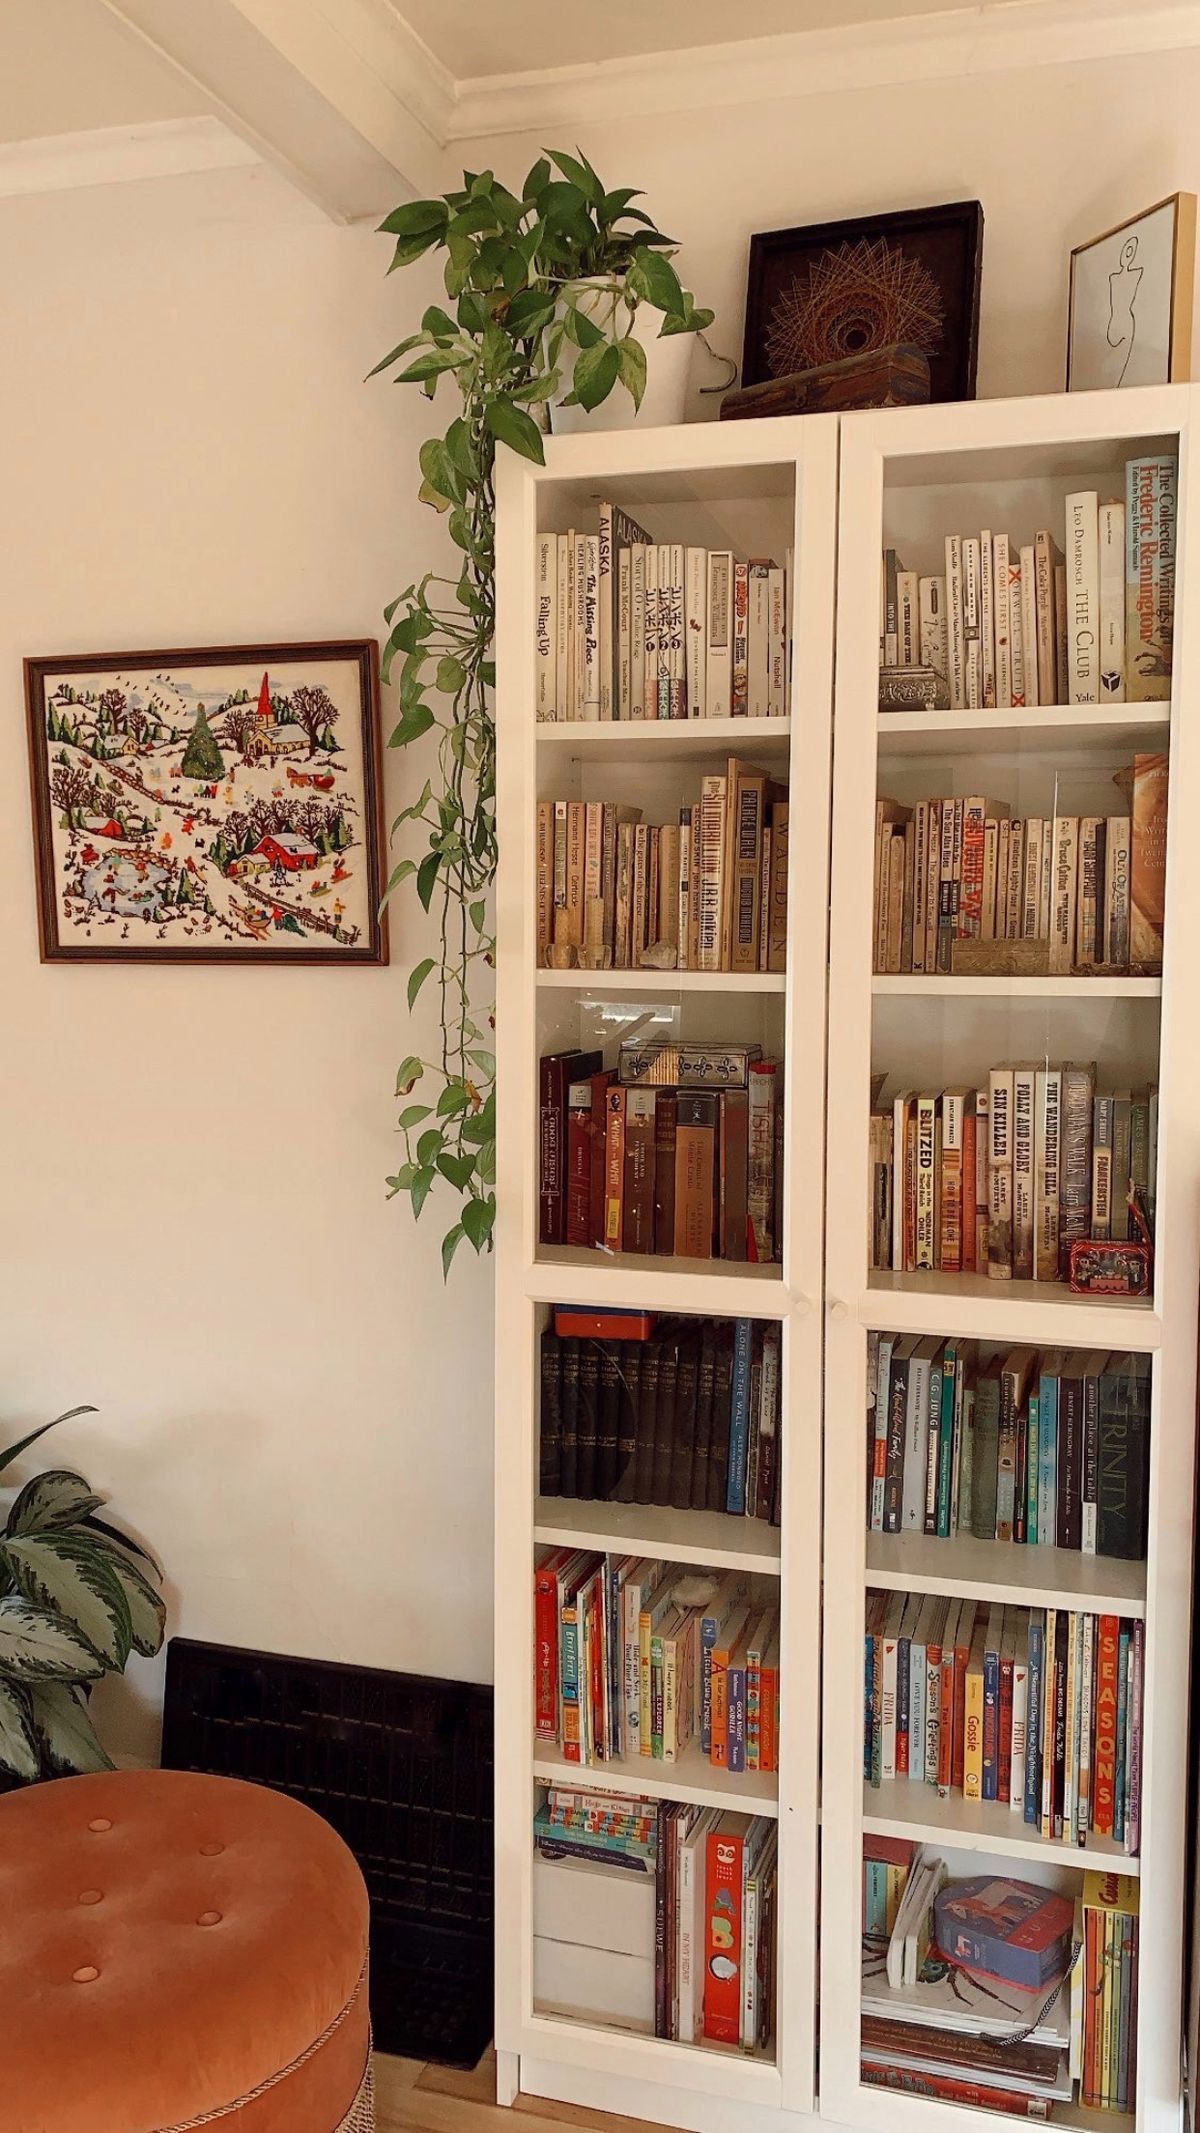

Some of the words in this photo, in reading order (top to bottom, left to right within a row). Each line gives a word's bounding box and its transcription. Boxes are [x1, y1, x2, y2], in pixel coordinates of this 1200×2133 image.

[1159, 463, 1174, 491] The
[1140, 464, 1158, 536] Frederic
[1159, 493, 1174, 560] Collected
[577, 543, 585, 576] HEALING
[599, 517, 610, 577] ALASKA
[586, 576, 597, 593] The
[773, 587, 781, 599] Ian
[1137, 540, 1157, 641] Remington
[1157, 561, 1175, 623] Writings
[577, 578, 585, 626] MUSHROOMS
[1075, 588, 1089, 624] THE
[537, 596, 551, 637] Falling
[585, 596, 597, 635] Missing
[711, 603, 722, 638] Williams
[773, 600, 781, 636] McEwan
[538, 638, 551, 656] Up
[586, 637, 599, 665] Piece
[904, 637, 911, 646] OF
[773, 656, 781, 689] Nutshell
[1076, 693, 1096, 702] Yale
[740, 791, 757, 828] PALACE
[943, 808, 953, 820] The
[571, 806, 579, 841] Hermann
[943, 821, 952, 834] Sun
[571, 843, 579, 866] Hesse
[638, 836, 646, 849] the
[739, 830, 756, 858] WALK
[943, 835, 952, 849] Also
[1058, 839, 1071, 864] Bruce
[636, 850, 646, 870] gates
[942, 850, 952, 868] Rises
[637, 871, 645, 880] of
[637, 881, 645, 894] the
[773, 821, 788, 953] WALDEN
[1057, 864, 1071, 891] Catton
[571, 874, 579, 907] Gertrude
[699, 879, 718, 910] J.R.R.
[739, 879, 753, 906] NAGUIB
[699, 910, 718, 949] Tolkien
[739, 907, 753, 943] MAHFOUZ
[993, 1089, 1007, 1109] SIN
[1016, 1083, 1030, 1115] FOLLY
[1045, 1081, 1057, 1103] THE
[1067, 1080, 1087, 1109] DEAD
[1099, 1100, 1108, 1118] MARY
[610, 1121, 621, 1147] WHAT
[920, 1108, 932, 1169] BLITZED
[993, 1111, 1007, 1156] KILLER
[1016, 1117, 1030, 1138] AND
[1045, 1105, 1057, 1169] WANDERING
[1067, 1111, 1087, 1143] MAN'S
[1099, 1117, 1108, 1143] SHELLEY
[1016, 1140, 1030, 1174] GLORY
[1067, 1146, 1086, 1175] WALK
[610, 1159, 621, 1185] WHAT
[1045, 1171, 1056, 1196] HILL
[946, 1180, 956, 1196] HOW
[1062, 1183, 1085, 1206] Larry
[1097, 1155, 1109, 1217] FRANKENSTEIN
[946, 1198, 955, 1207] TO
[609, 1211, 617, 1234] USED
[946, 1219, 955, 1242] ALONE
[737, 1324, 746, 1356] ALONE
[737, 1360, 746, 1375] ON
[736, 1378, 745, 1396] THE
[894, 1377, 906, 1392] The
[929, 1398, 939, 1426] JUNG
[1066, 1391, 1074, 1417] ERNEST
[1088, 1383, 1096, 1417] another
[735, 1401, 743, 1427] WALL
[1066, 1417, 1074, 1458] HEMINGWAY
[1086, 1420, 1095, 1445] place
[764, 1445, 772, 1466] Daniel
[887, 1435, 902, 1459] Family
[1087, 1447, 1095, 1457] at
[1087, 1460, 1095, 1474] the
[1101, 1402, 1128, 1520] TRINITY
[762, 1469, 771, 1485] Pyne
[1086, 1477, 1095, 1501] table
[703, 1647, 712, 1674] Little
[711, 1661, 727, 1675] A
[1031, 1661, 1040, 1670] A
[703, 1677, 712, 1699] Blue
[913, 1682, 921, 1700] LOVE
[928, 1670, 940, 1714] Season's
[1030, 1671, 1040, 1707] Beautiful
[703, 1699, 712, 1730] Truck
[716, 1695, 724, 1719] activist
[883, 1691, 894, 1726] FRIDA
[913, 1700, 921, 1716] YOU
[1028, 1708, 1038, 1722] Day
[1098, 1636, 1117, 1804] SEASONS
[913, 1716, 921, 1749] FOREVER
[927, 1719, 941, 1767] Greetings
[967, 1715, 980, 1752] Gossie
[1013, 1721, 1025, 1755] FRIDA
[1029, 1732, 1037, 1743] the
[1056, 1720, 1065, 1740] Frida
[1056, 1741, 1064, 1761] Kahlo
[1027, 1745, 1037, 1796] Neighborhood
[655, 1909, 664, 1952] SULWE
[682, 1933, 690, 1942] IN
[682, 1942, 690, 1955] MY
[682, 1955, 690, 1985] HEART
